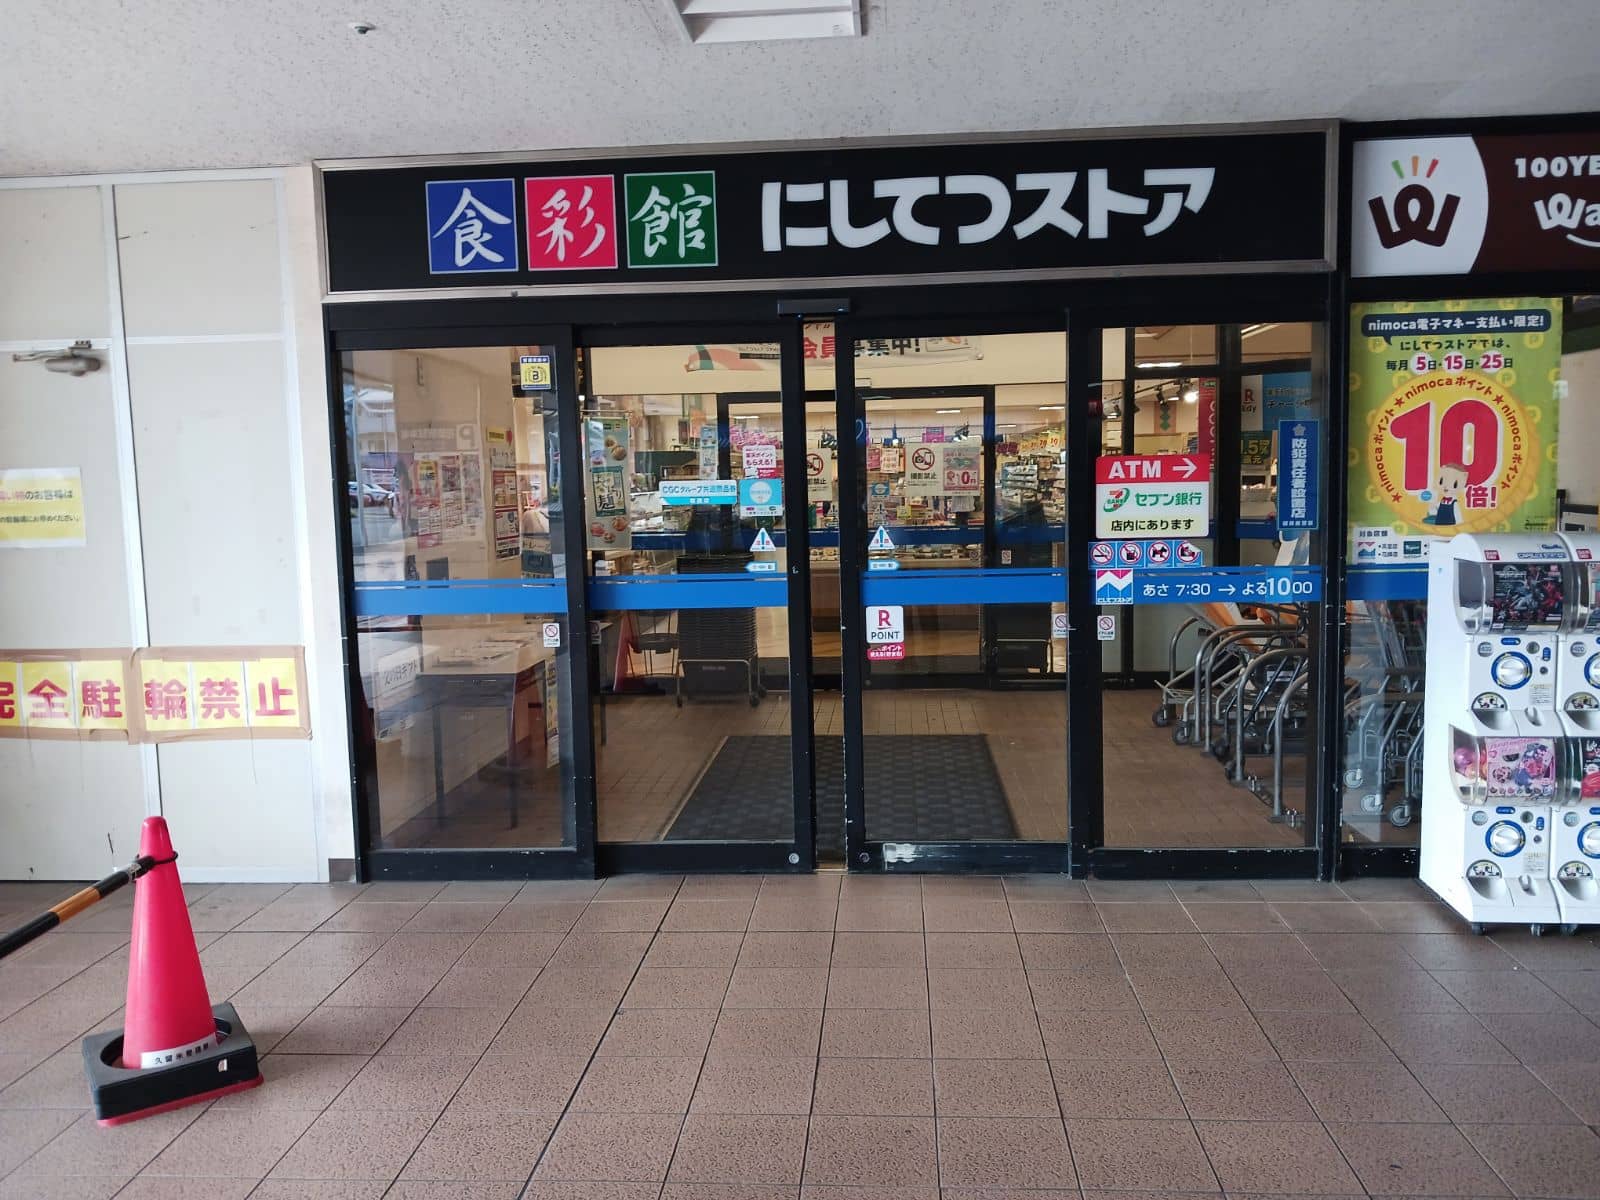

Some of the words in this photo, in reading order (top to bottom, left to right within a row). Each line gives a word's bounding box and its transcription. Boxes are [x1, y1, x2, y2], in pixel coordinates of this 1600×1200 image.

[433, 184, 712, 267] 食彩館
[761, 167, 1216, 252] にしてつストア
[1400, 338, 1511, 351] にしてつストアでは、
[1386, 360, 1408, 371] 毎月
[1390, 400, 1499, 491] 10
[1108, 461, 1162, 479] ATM
[1135, 492, 1202, 506] セブン銀行
[1466, 486, 1497, 508] 倍!
[1111, 519, 1194, 532] 店内にあります
[1143, 584, 1168, 596] あさ
[1176, 583, 1210, 596] 7:30
[871, 631, 899, 640] POINT
